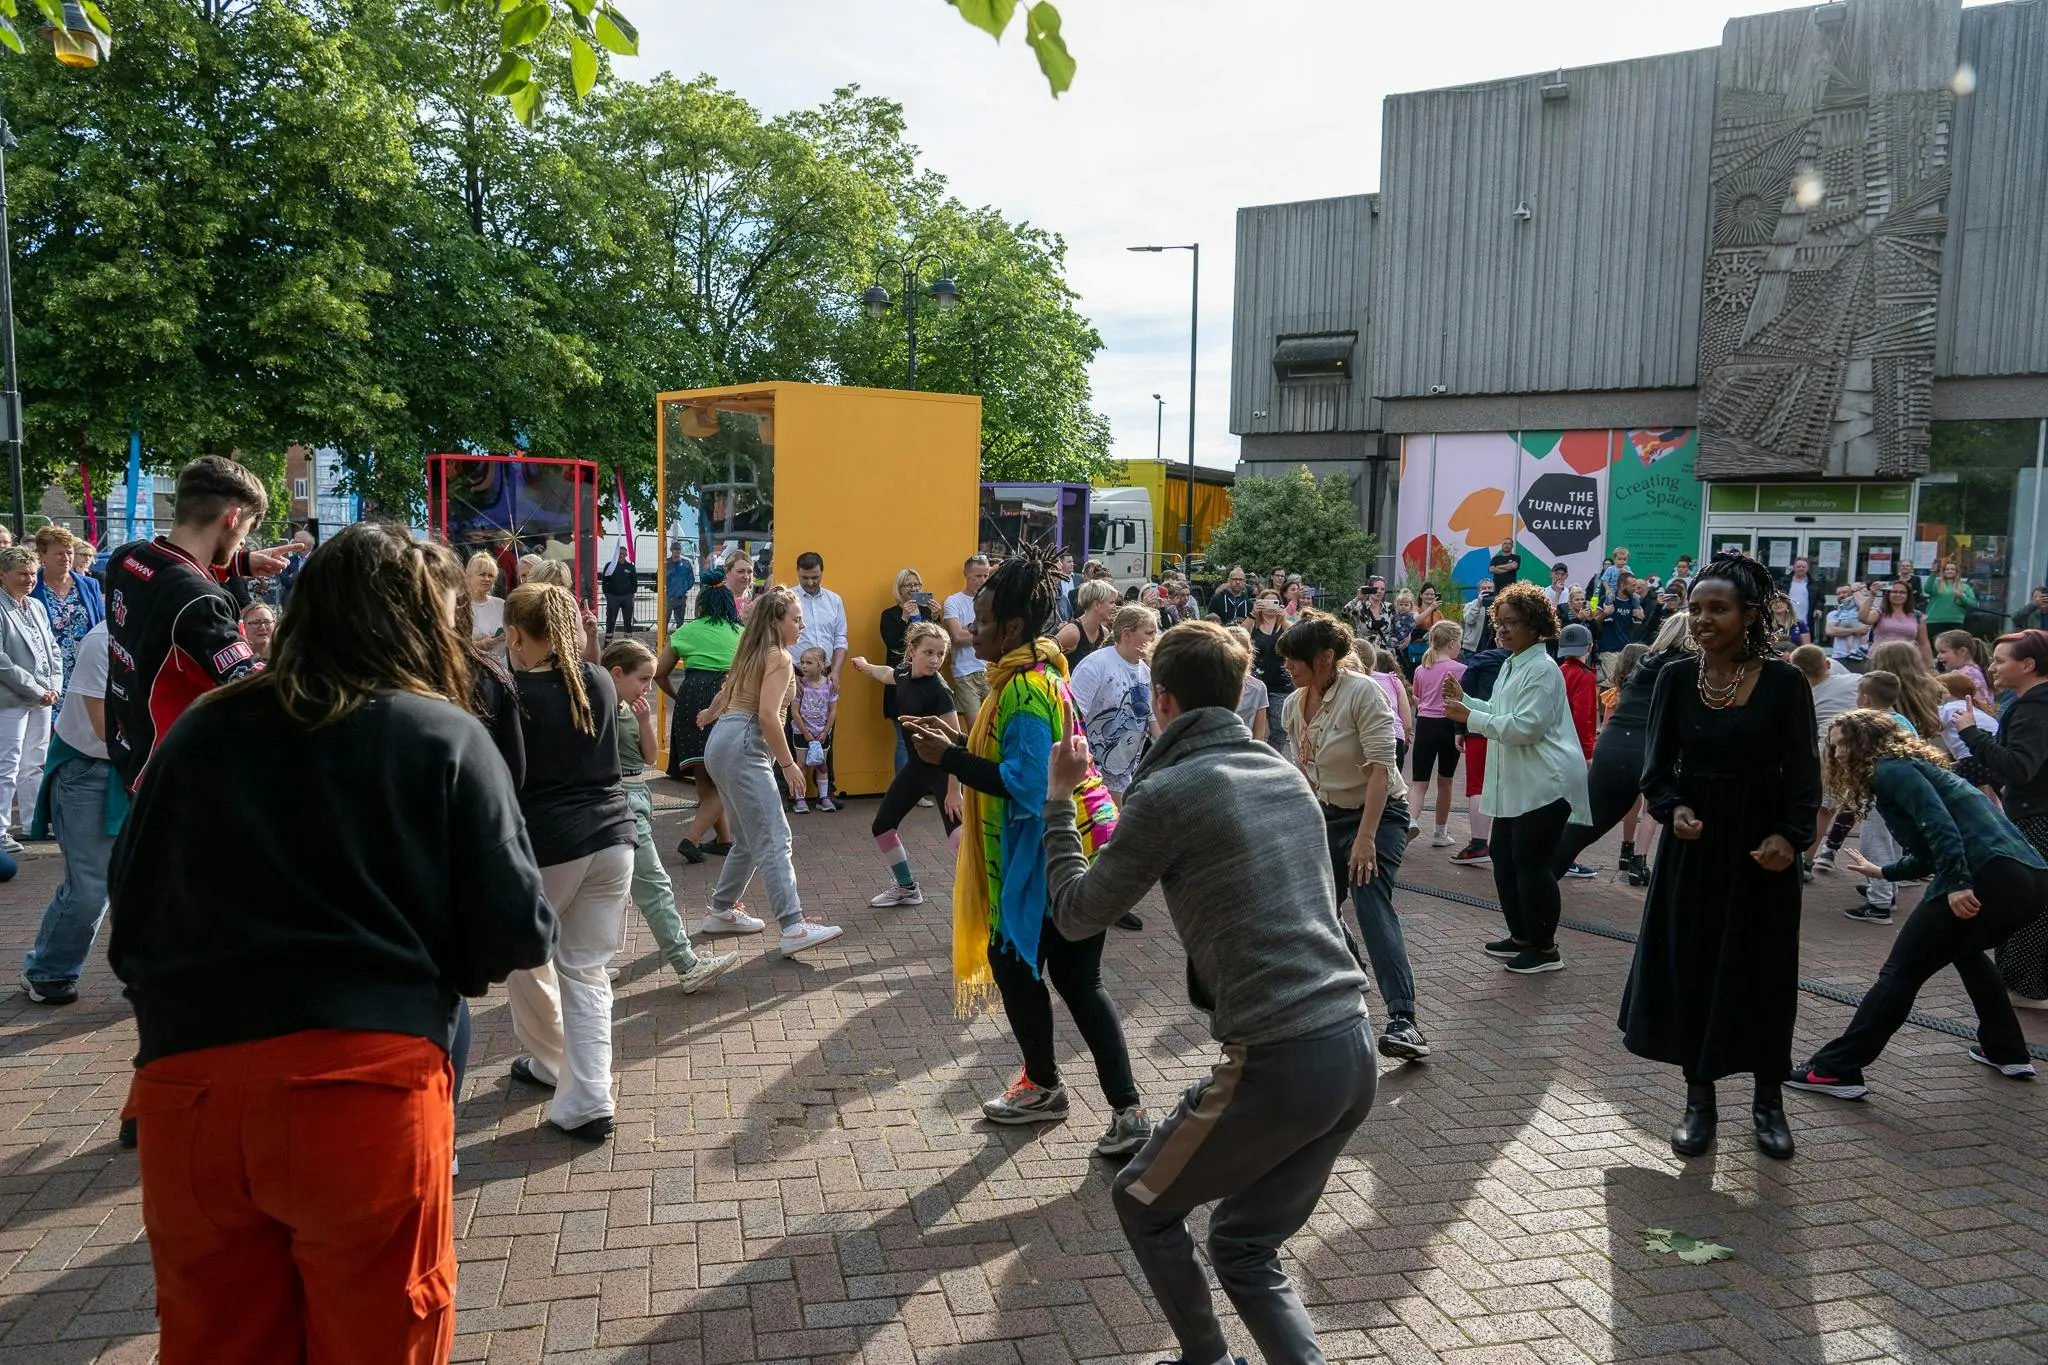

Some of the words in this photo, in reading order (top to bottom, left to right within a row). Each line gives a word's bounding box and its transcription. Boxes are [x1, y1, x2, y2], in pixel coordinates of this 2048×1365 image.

[1615, 473, 1680, 501] Creating
[1569, 491, 1594, 502] THE
[1646, 490, 1697, 511] Space:
[1775, 499, 1802, 508] Leigh
[1804, 499, 1838, 508] Library
[1528, 499, 1595, 518] TURNPIKE
[1532, 519, 1593, 531] GALLERY
